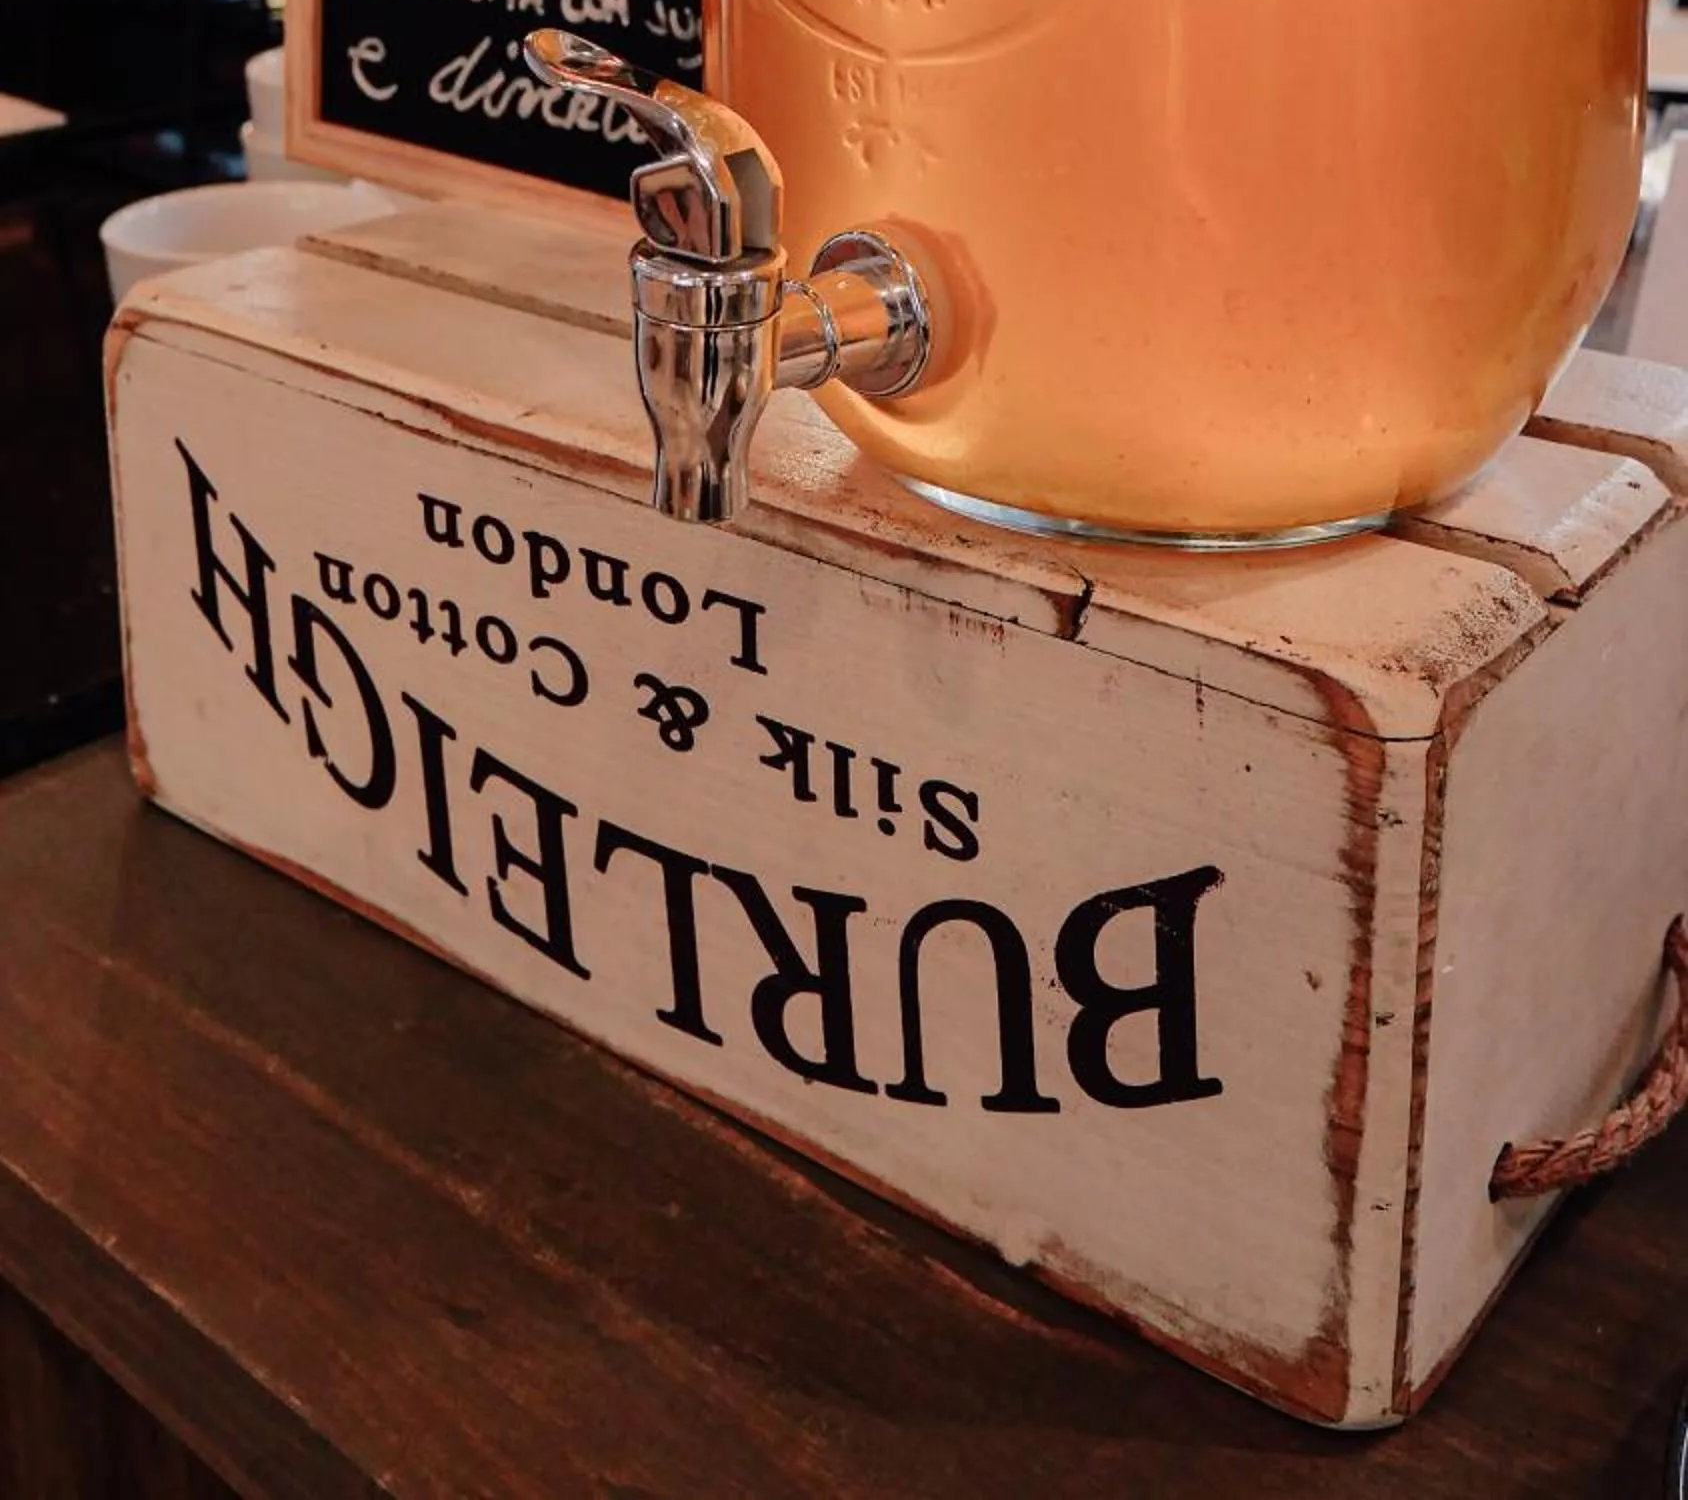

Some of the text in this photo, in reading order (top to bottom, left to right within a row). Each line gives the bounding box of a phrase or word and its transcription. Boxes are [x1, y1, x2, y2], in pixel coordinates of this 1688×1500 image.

[313, 551, 980, 862] Silk & Cotton
[417, 493, 768, 676] London
[175, 436, 1225, 1114] BURLEIGH
